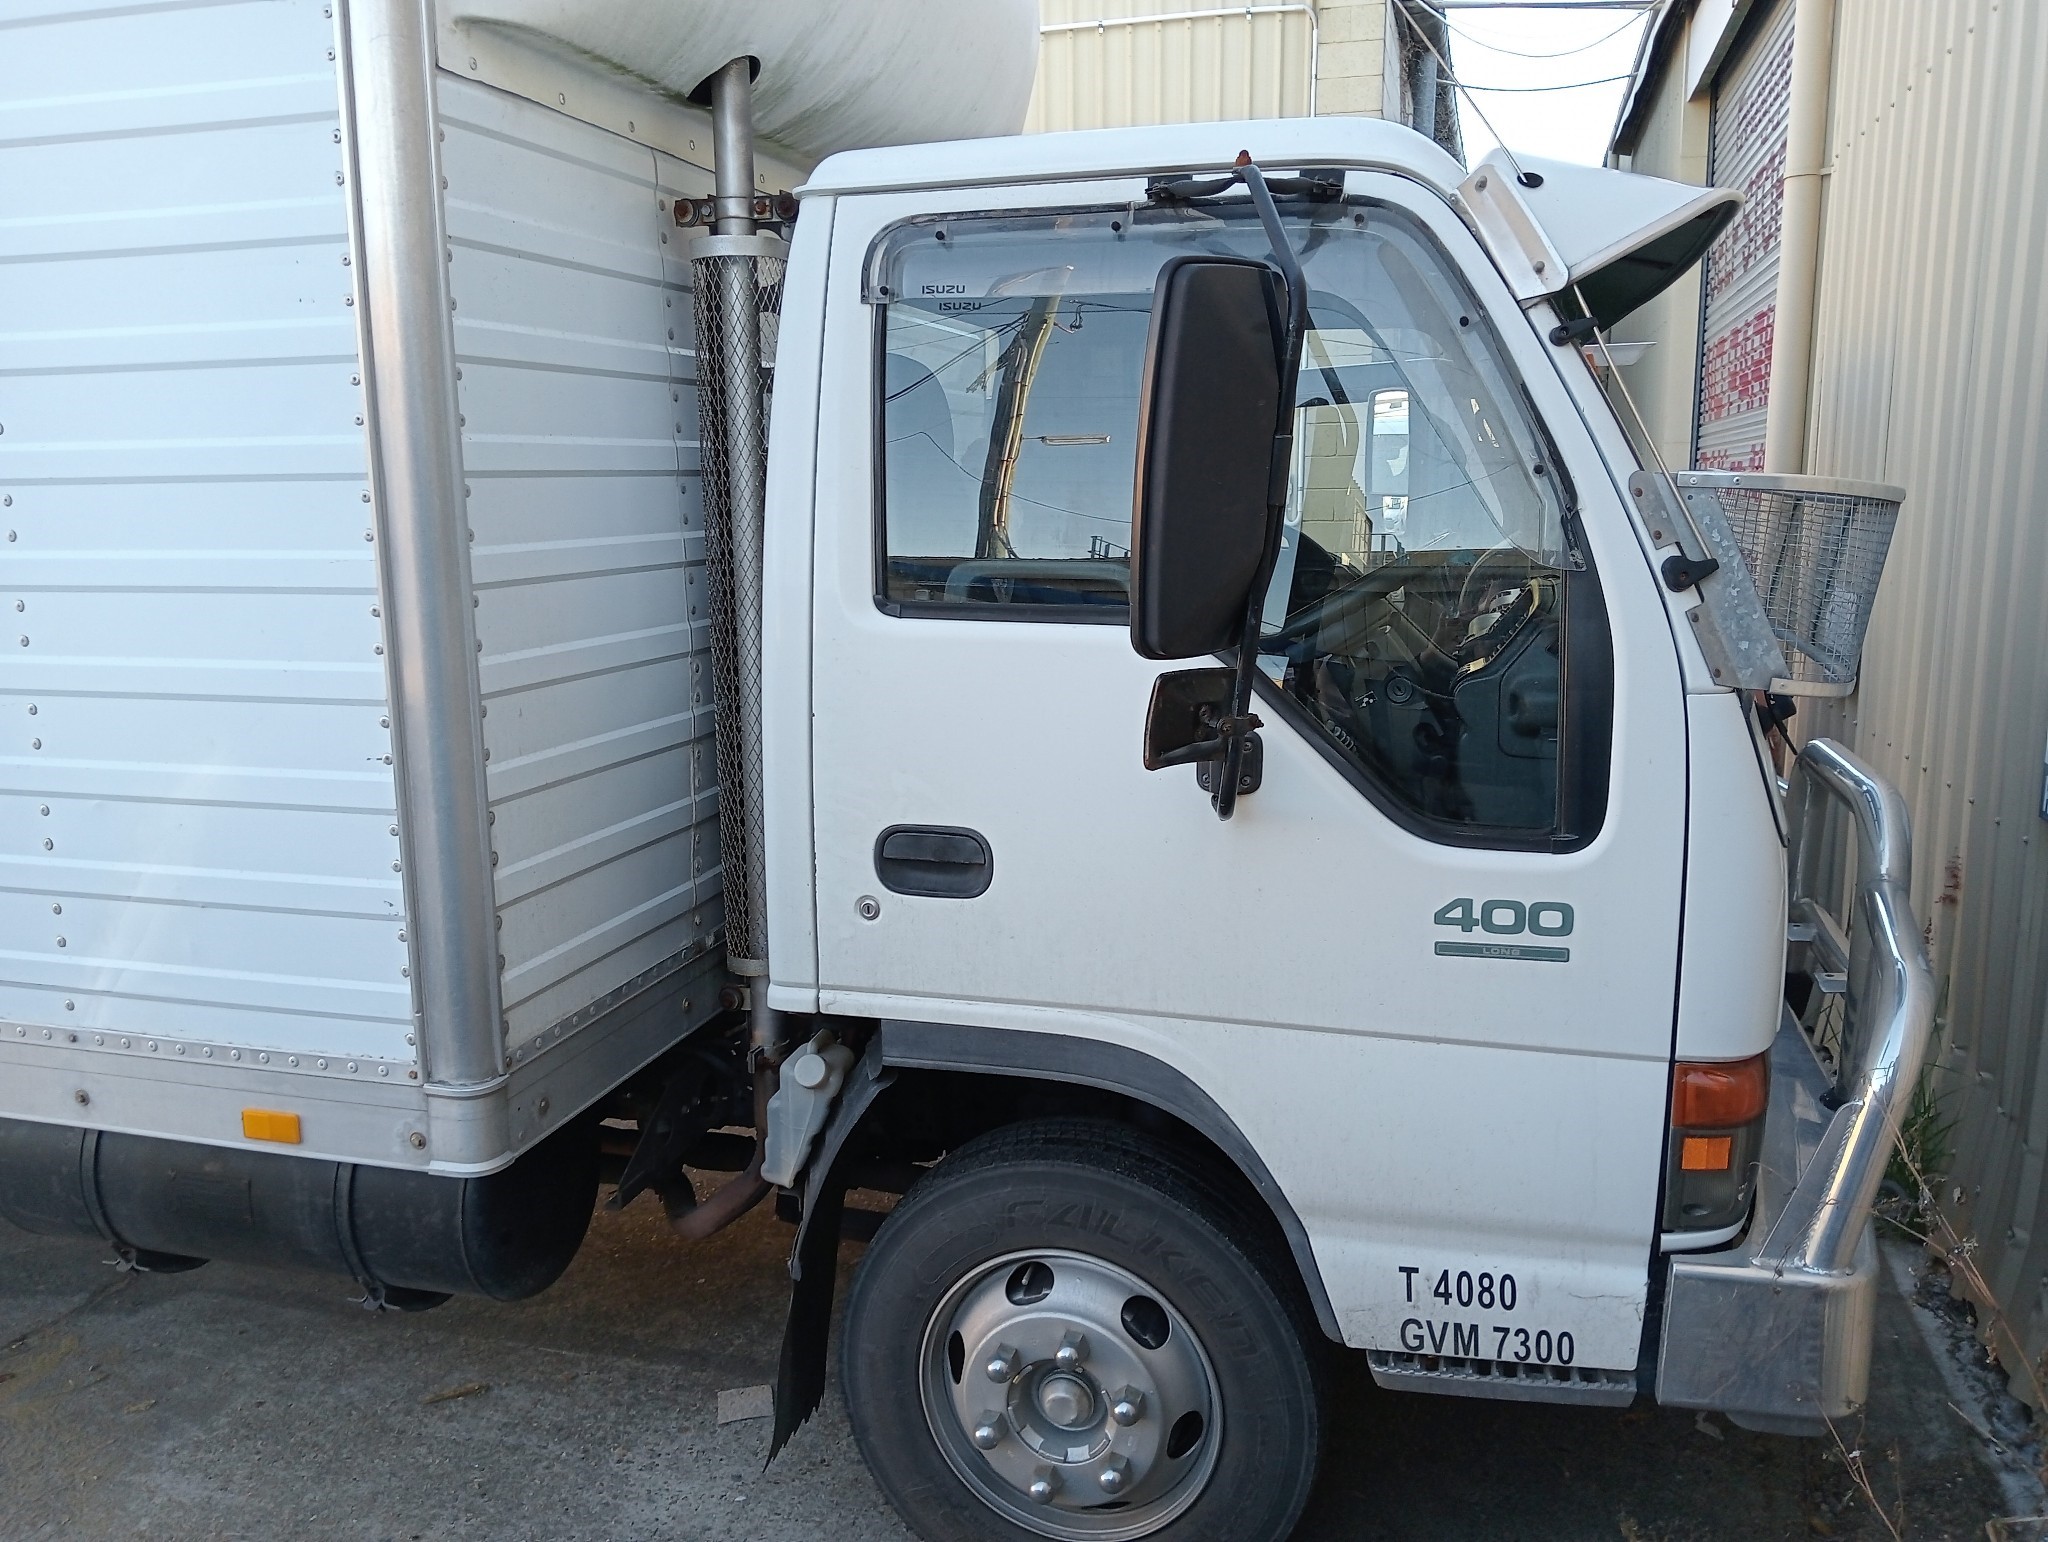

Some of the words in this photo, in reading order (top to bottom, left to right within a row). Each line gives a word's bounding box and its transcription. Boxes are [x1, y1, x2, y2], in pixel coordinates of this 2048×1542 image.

[922, 285, 965, 294] ISUZU
[939, 302, 982, 311] ISUZU
[1434, 897, 1574, 937] 400
[1483, 947, 1521, 956] LONG
[1399, 1266, 1420, 1302] T
[1433, 1269, 1517, 1311] 4080
[1400, 1318, 1479, 1357] GVM
[1493, 1326, 1574, 1365] 7300
